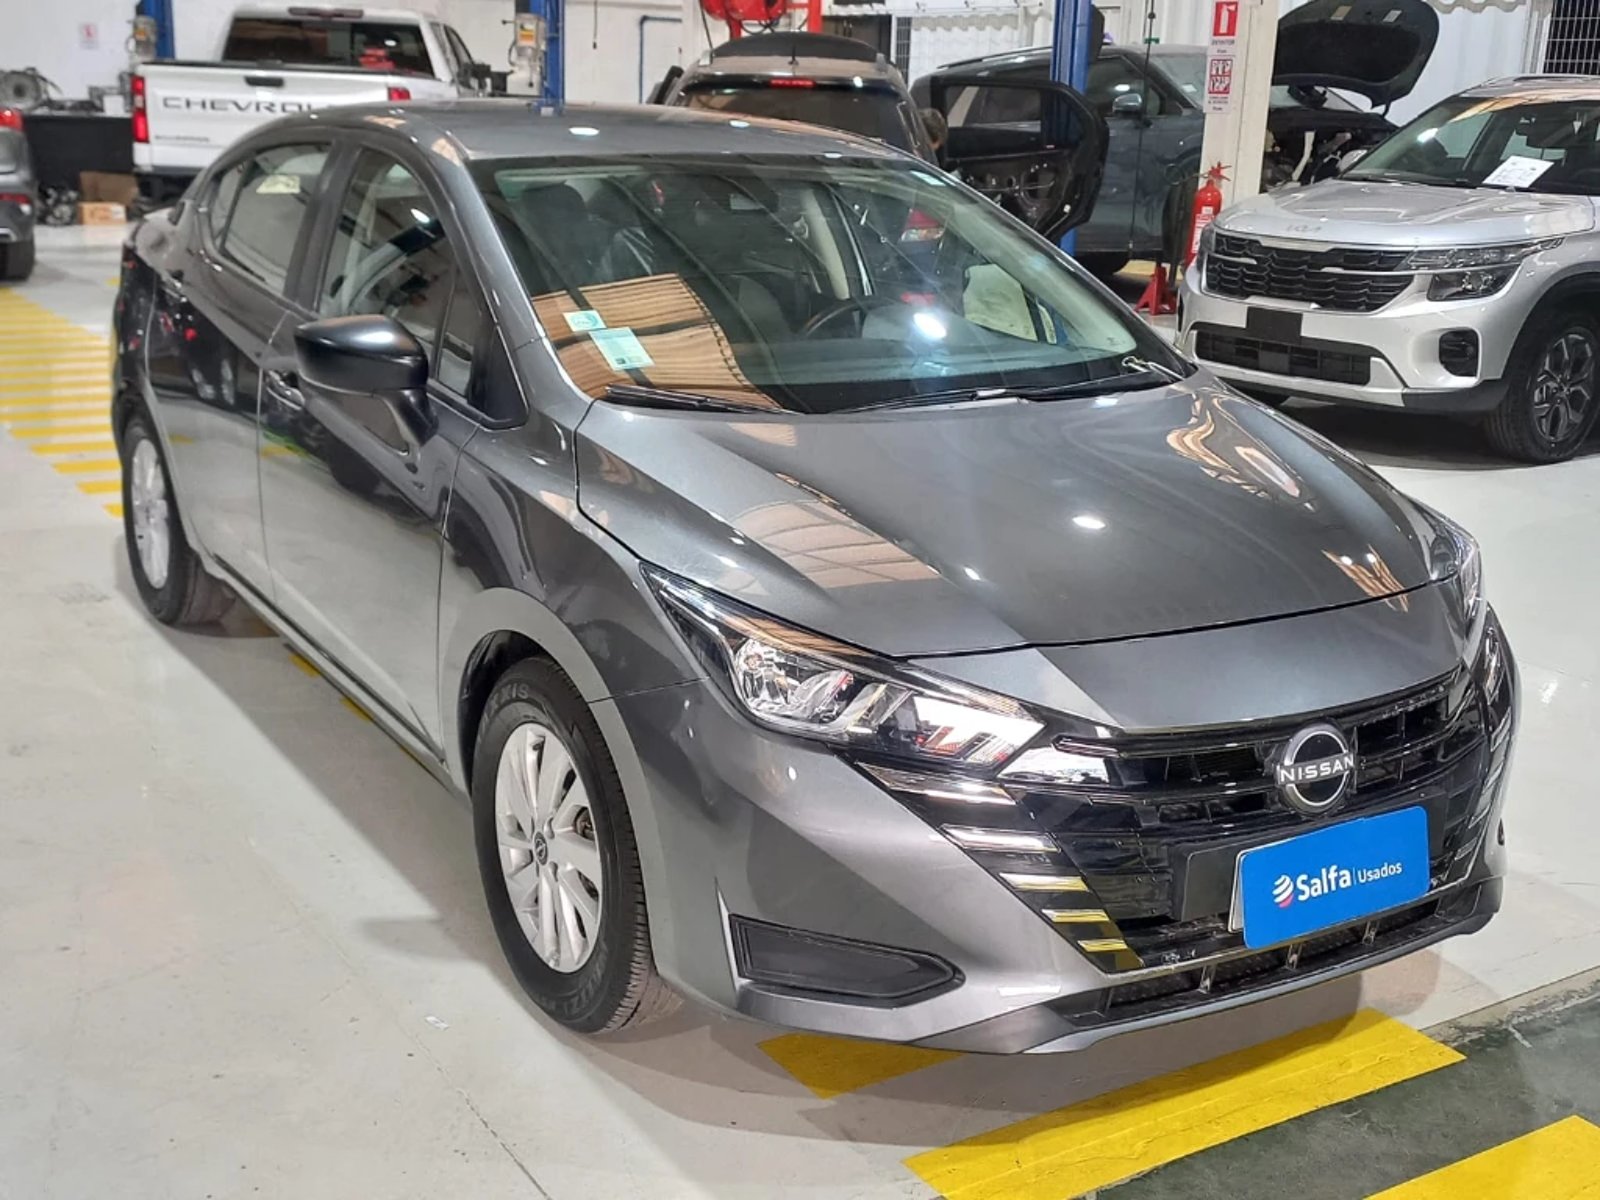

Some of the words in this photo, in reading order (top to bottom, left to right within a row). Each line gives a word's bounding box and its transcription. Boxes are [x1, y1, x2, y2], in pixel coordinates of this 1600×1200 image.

[1279, 756, 1355, 783] NISSAN
[1296, 865, 1351, 902] Salfa
[1357, 862, 1402, 884] Usados
